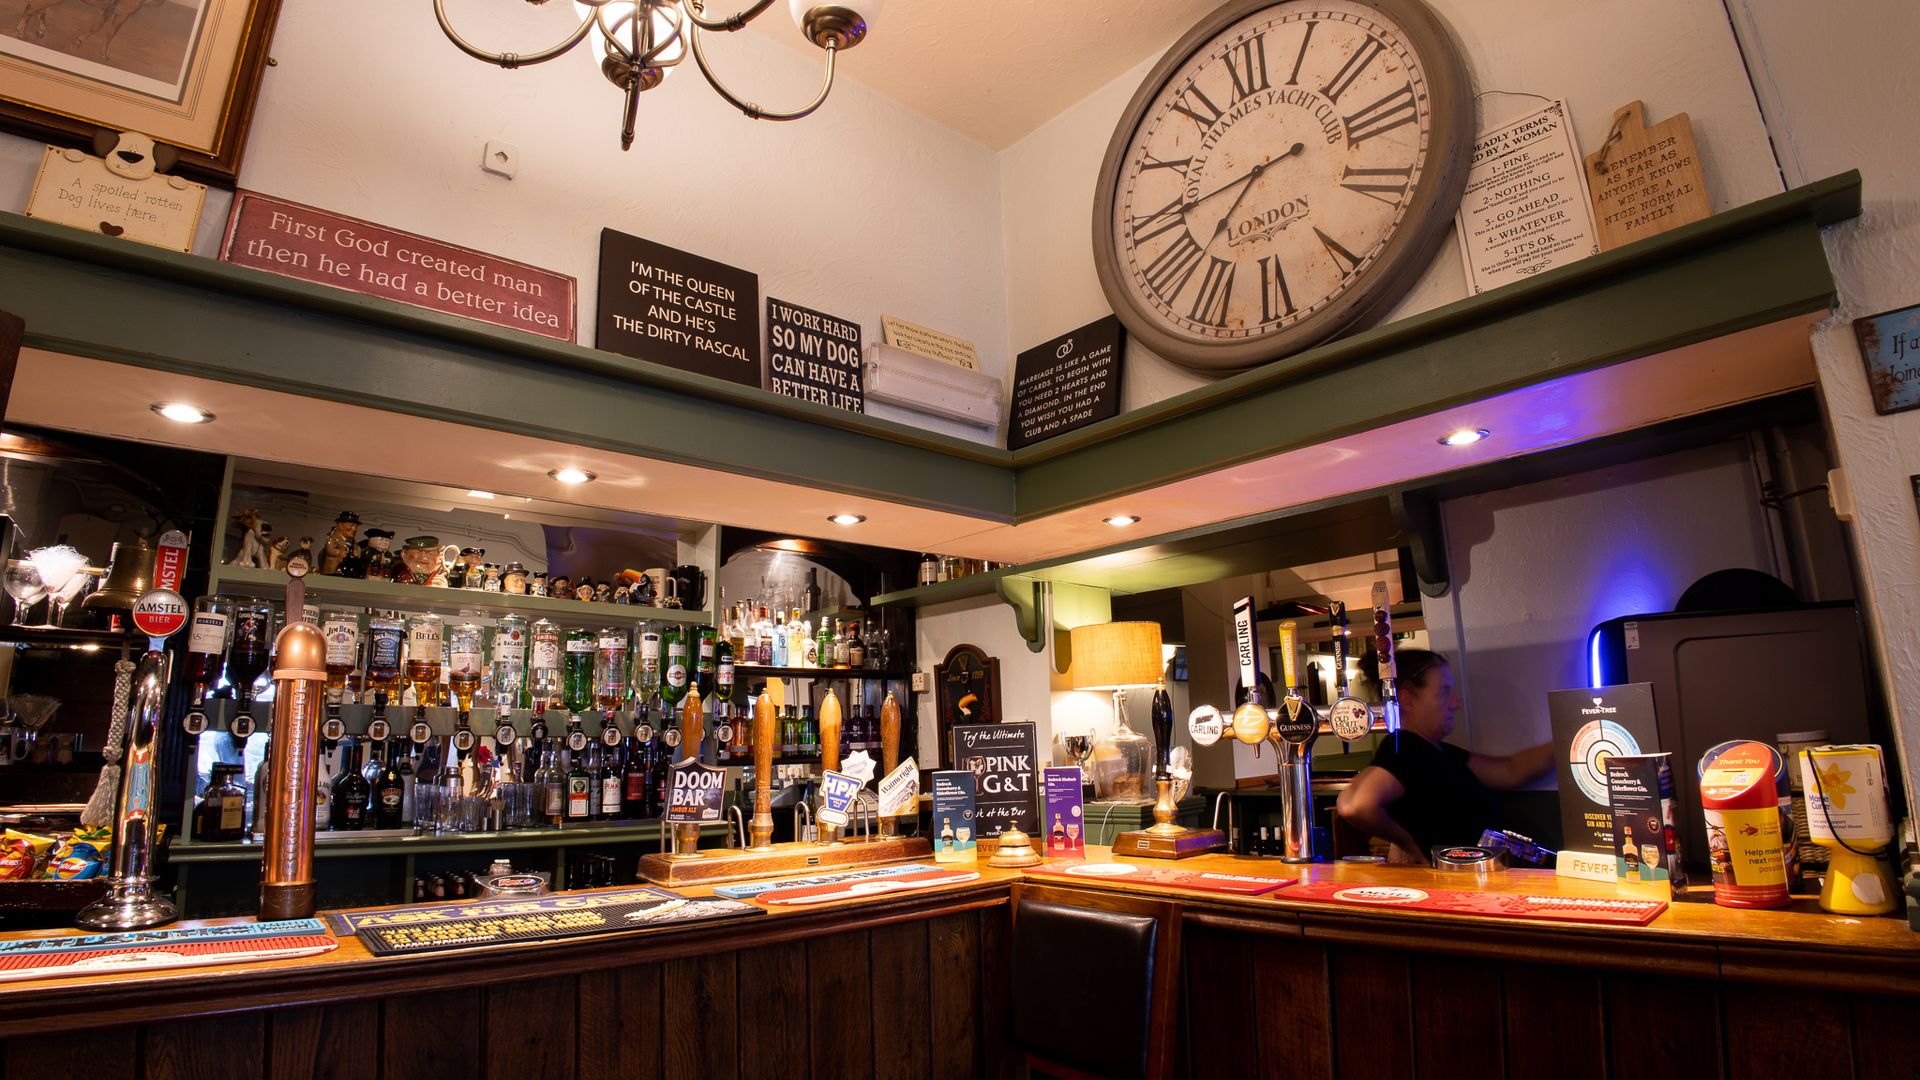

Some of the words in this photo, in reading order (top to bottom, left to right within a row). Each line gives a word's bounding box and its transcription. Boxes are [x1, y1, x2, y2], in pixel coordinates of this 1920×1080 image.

[1218, 31, 1271, 109] XII
[1319, 33, 1388, 105] II
[1168, 80, 1226, 141] XI
[1342, 79, 1419, 151] III
[1511, 115, 1550, 136] TERMS
[1186, 148, 1211, 205] OYAL
[1204, 94, 1262, 152] THAMES
[1267, 88, 1321, 109] YACHT
[1314, 103, 1344, 145] CLUB
[1485, 146, 1500, 157] BY
[1502, 142, 1511, 151] A
[1512, 121, 1558, 146] WOMAN
[1610, 136, 1677, 172] EMEMBER
[1138, 151, 1193, 179] X
[1503, 152, 1531, 169] FINE
[1606, 173, 1622, 186] AS
[1626, 159, 1654, 178] FAR
[1660, 149, 1678, 164] AS
[71, 177, 82, 188] A
[92, 182, 140, 201] spoiled
[1494, 172, 1552, 200] NOTHING
[1598, 176, 1646, 203] ANYONE
[1649, 157, 1692, 182] KNOWS
[1665, 179, 1673, 188] A
[58, 188, 84, 209] Dog
[88, 194, 122, 214] lives
[127, 203, 158, 223] here
[1226, 194, 1311, 242] LONDON
[1496, 209, 1515, 222] GO
[1516, 192, 1560, 215] AHEAD
[1604, 206, 1637, 226] NICE
[1640, 184, 1694, 212] NORMAL
[1624, 204, 1676, 232] FAMILY
[1498, 210, 1566, 240] WHATEVER
[1537, 233, 1557, 246] OK
[268, 212, 327, 242] First
[334, 228, 390, 258] God
[396, 248, 486, 282] created
[492, 272, 543, 298] man
[1141, 226, 1205, 309] VIII
[1313, 226, 1366, 280] V
[247, 240, 309, 268] then
[318, 253, 352, 276] he
[357, 263, 408, 292] had
[414, 280, 430, 297] a
[436, 282, 506, 314] better
[512, 302, 560, 329] idea
[631, 260, 652, 279] I'M
[655, 268, 684, 288] THE
[686, 278, 736, 302] QUEEN
[1186, 256, 1237, 328] VII
[1256, 253, 1299, 325] VI
[628, 280, 650, 296] OF
[652, 286, 682, 306] THE
[684, 296, 737, 322] CASTLE
[648, 305, 682, 324] AND
[684, 314, 716, 334] HE'S
[772, 304, 778, 320] I
[780, 306, 821, 332] WORK
[822, 318, 858, 342] HARD
[612, 314, 644, 335] THE
[648, 324, 692, 346] DIRTY
[694, 336, 750, 362] RASCAL
[772, 324, 796, 350] SO
[800, 332, 823, 358] MY
[827, 340, 860, 369] DOG
[1892, 332, 1906, 360] If
[772, 353, 806, 378] CAN
[808, 362, 848, 389] HAVE
[850, 374, 860, 392] A
[1017, 390, 1028, 398] OF
[1028, 380, 1054, 394] CARDS.
[1055, 374, 1065, 384] TO
[1066, 364, 1090, 380] BEGIN
[1091, 356, 1112, 369] WITH
[1018, 367, 1055, 388] MARRIAGE
[1056, 364, 1063, 372] IS
[1064, 357, 1080, 370] LIKE
[1088, 344, 1112, 360] GAME
[772, 377, 829, 406] BETTER
[831, 391, 862, 414] LIFE
[1017, 411, 1023, 419] A
[1063, 394, 1072, 402] IN
[1074, 388, 1088, 398] THE
[1089, 381, 1107, 393] END
[1018, 396, 1034, 408] YOU
[1034, 390, 1054, 402] NEED
[1061, 376, 1089, 392] HEARTS
[1090, 369, 1108, 381] AND
[1020, 417, 1036, 429] YOU
[1037, 411, 1056, 422] WISH
[1058, 404, 1074, 416] YOU
[1075, 398, 1092, 409] HAD
[1093, 395, 1100, 403] A
[1024, 426, 1042, 438] CLUB
[1042, 420, 1060, 432] AND
[1062, 418, 1068, 426] A
[1069, 408, 1094, 423] SPADE
[161, 548, 180, 591] MSTEL
[138, 602, 184, 614] AMSTEL
[149, 616, 170, 624] BIER
[326, 626, 338, 638] JIM
[338, 624, 356, 638] BEAM
[415, 632, 440, 641] BELL'S
[1236, 619, 1252, 667] CARLING
[1334, 641, 1343, 670] GUINNESS
[1280, 724, 1312, 732] GUINNESS
[1582, 707, 1617, 715] FEVER-TREE
[963, 731, 978, 748] Try
[980, 730, 992, 740] the
[992, 730, 1025, 740] Ultimate
[1190, 724, 1219, 736] CARLING
[674, 771, 724, 790] DOOM
[880, 764, 914, 794] Wainwright
[986, 755, 1031, 772] PINK
[672, 788, 705, 806] BAR
[824, 776, 859, 798] HPA
[983, 773, 1032, 794] G&T
[976, 808, 984, 818] sk
[986, 808, 996, 817] at
[997, 808, 1010, 817] the
[1010, 806, 1026, 816] Bar
[1584, 812, 1607, 821] DISCOVER
[1744, 849, 1764, 857] Help
